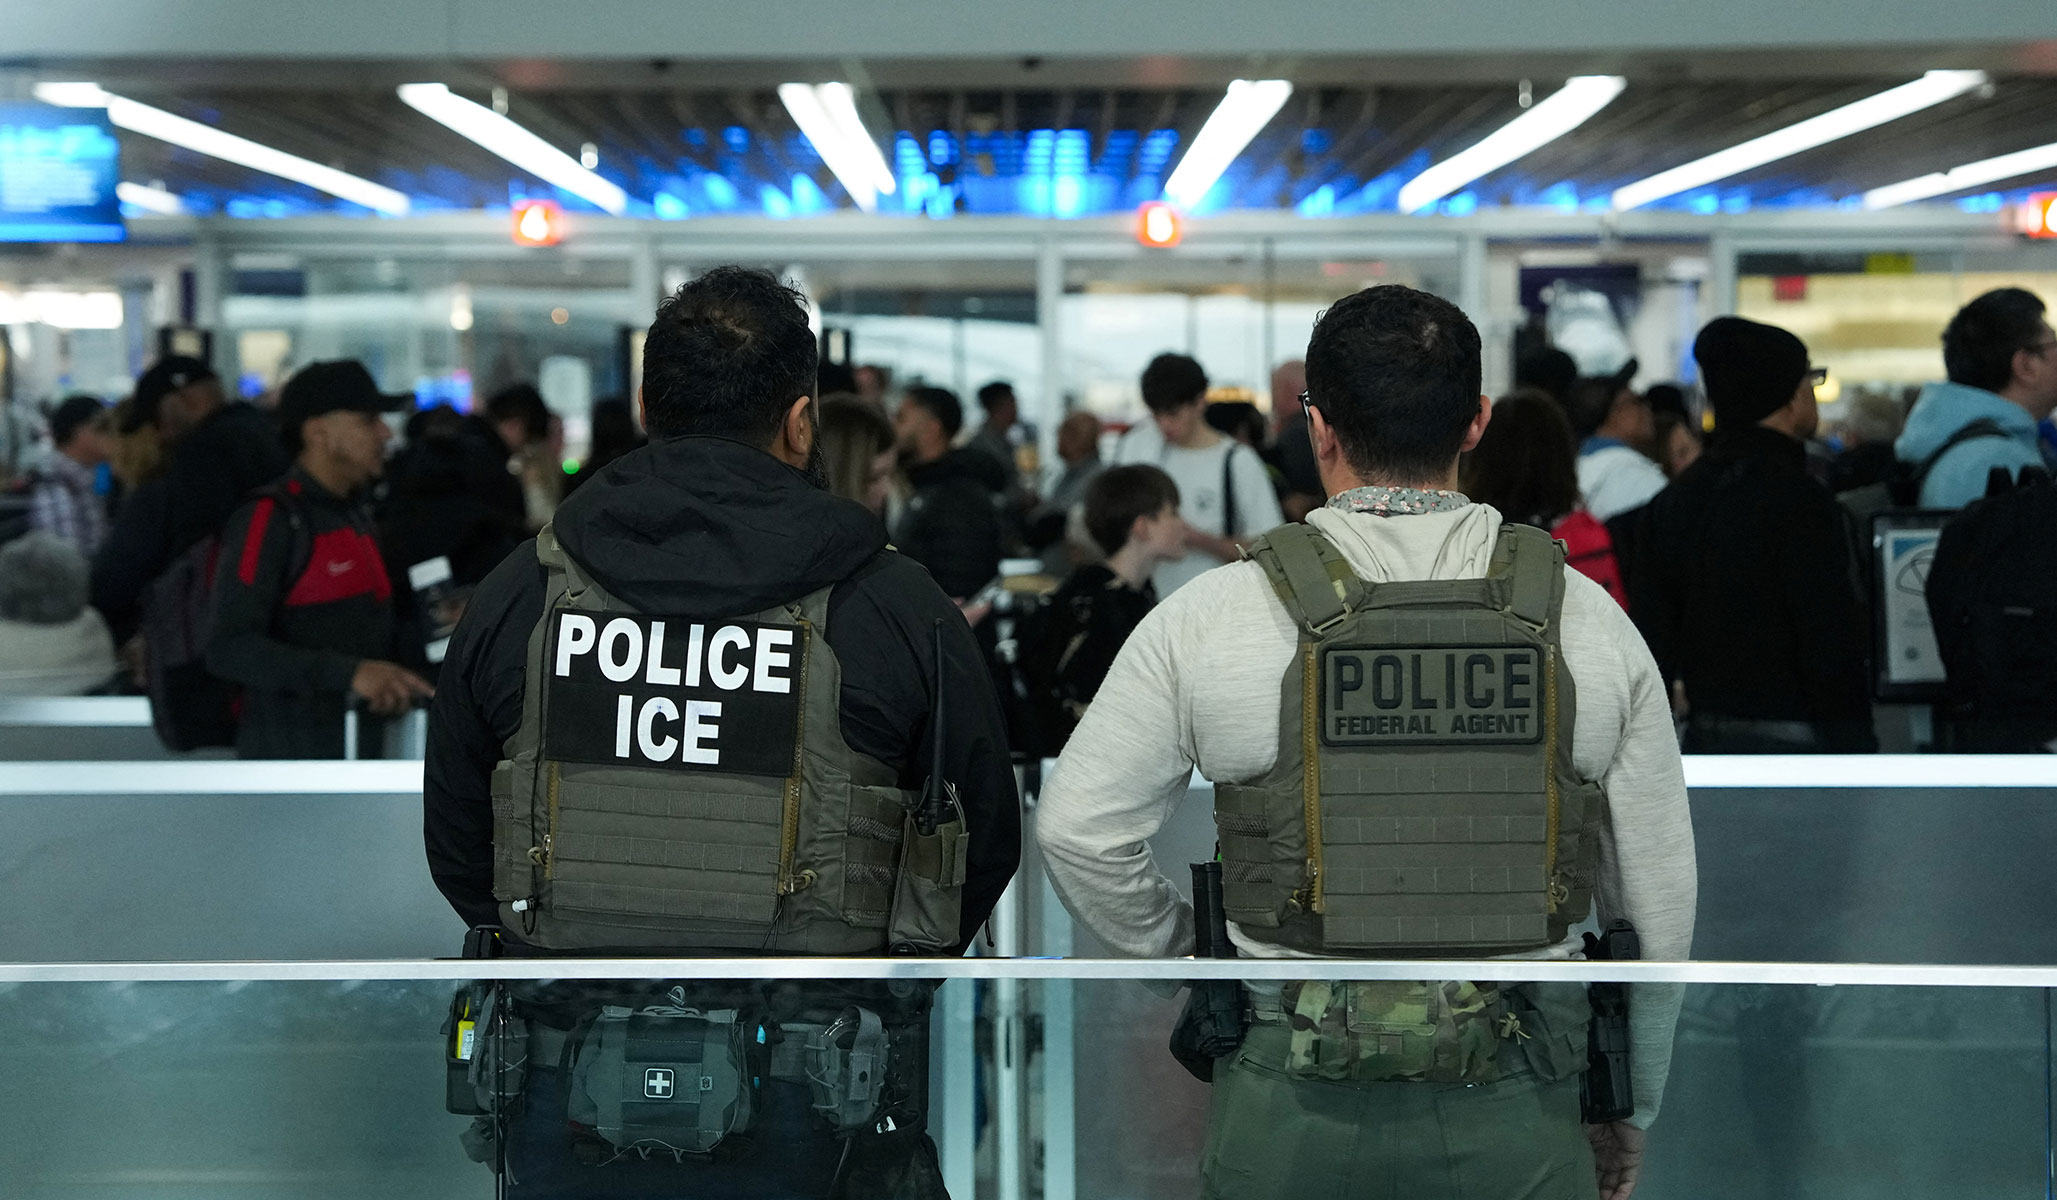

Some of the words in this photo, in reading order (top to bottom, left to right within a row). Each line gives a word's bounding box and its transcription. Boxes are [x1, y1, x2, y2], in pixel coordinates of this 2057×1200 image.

[555, 613, 794, 694] POLICE
[1333, 653, 1532, 711] POLICE
[615, 694, 723, 765] ICE
[1334, 714, 1438, 736] FEDERAL
[1449, 713, 1530, 735] AGENT
